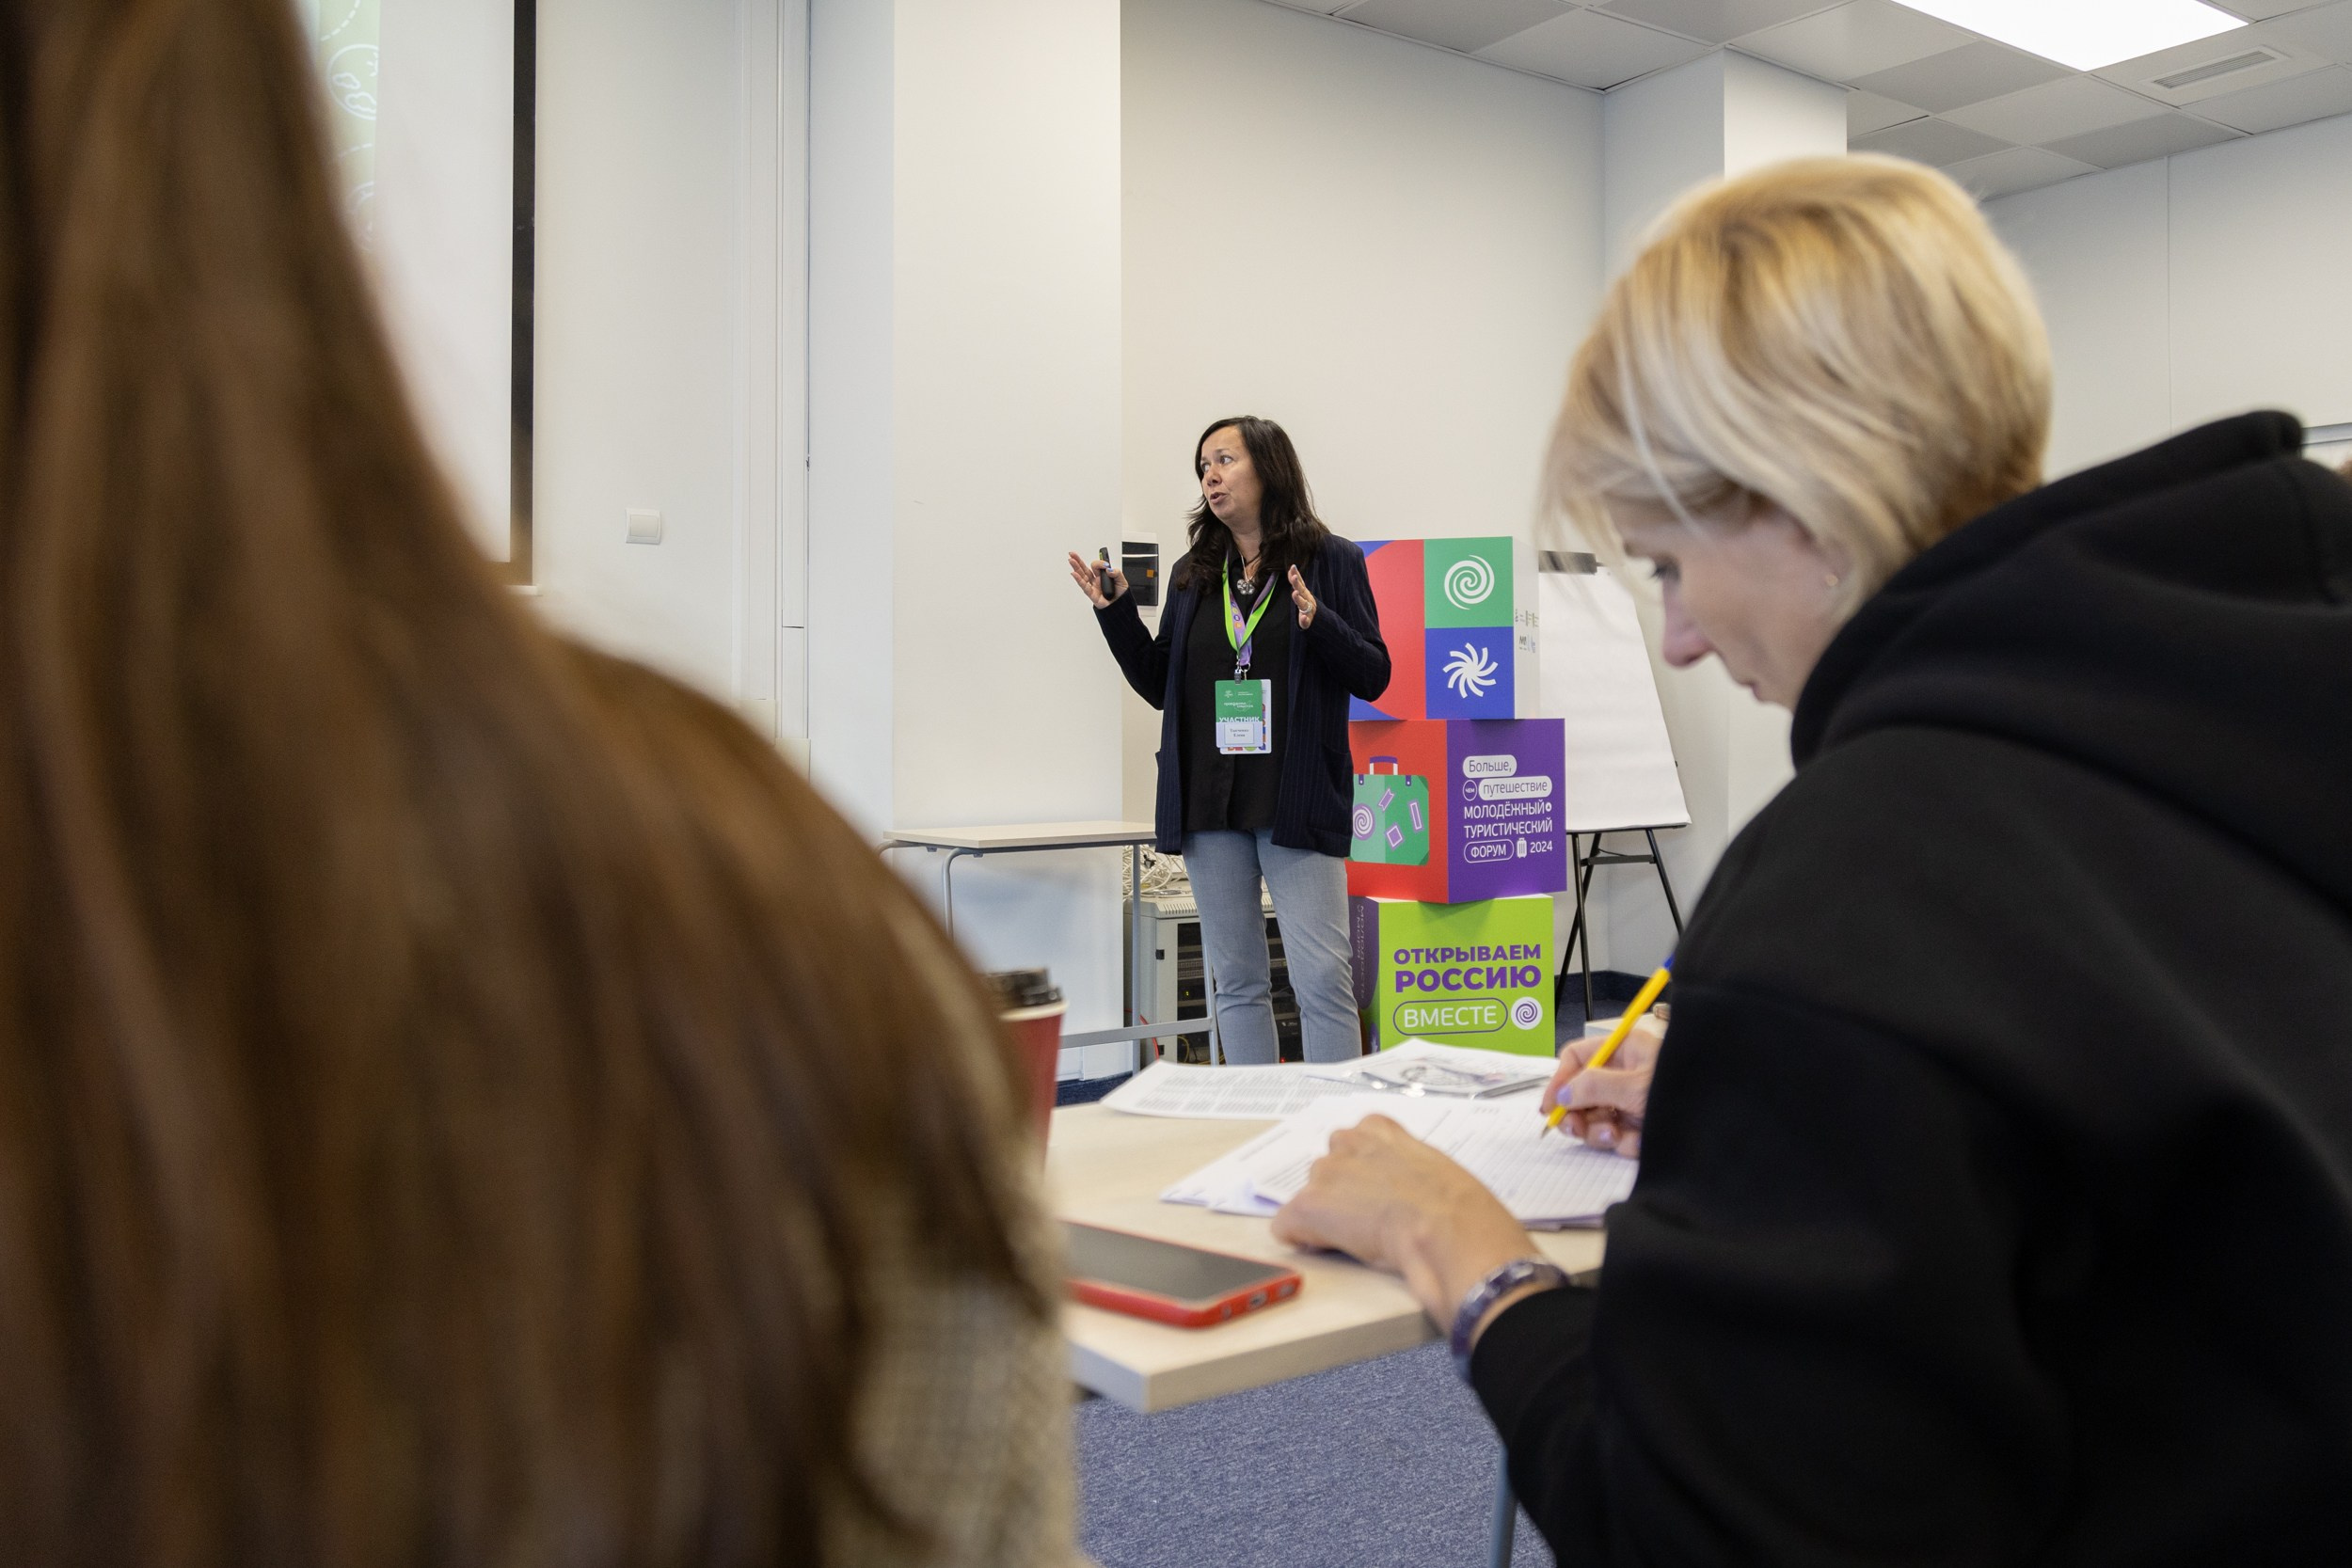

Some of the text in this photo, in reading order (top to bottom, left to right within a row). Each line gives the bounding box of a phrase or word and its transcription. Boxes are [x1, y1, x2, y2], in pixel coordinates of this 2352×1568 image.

[1469, 759, 1512, 772] Больше,
[1483, 781, 1548, 798] путешествие
[1464, 800, 1545, 819] МОЛОДЁЖНЫЙ
[1464, 816, 1553, 839] ТУРИСТИЧЕСКИЙ
[1470, 840, 1553, 858] ФОРУМ 2024
[1393, 943, 1541, 965] ОТКРЫВАЕМ
[1394, 964, 1542, 993] РОССИЮ
[1403, 1005, 1498, 1028] ВМЕСТЕ
